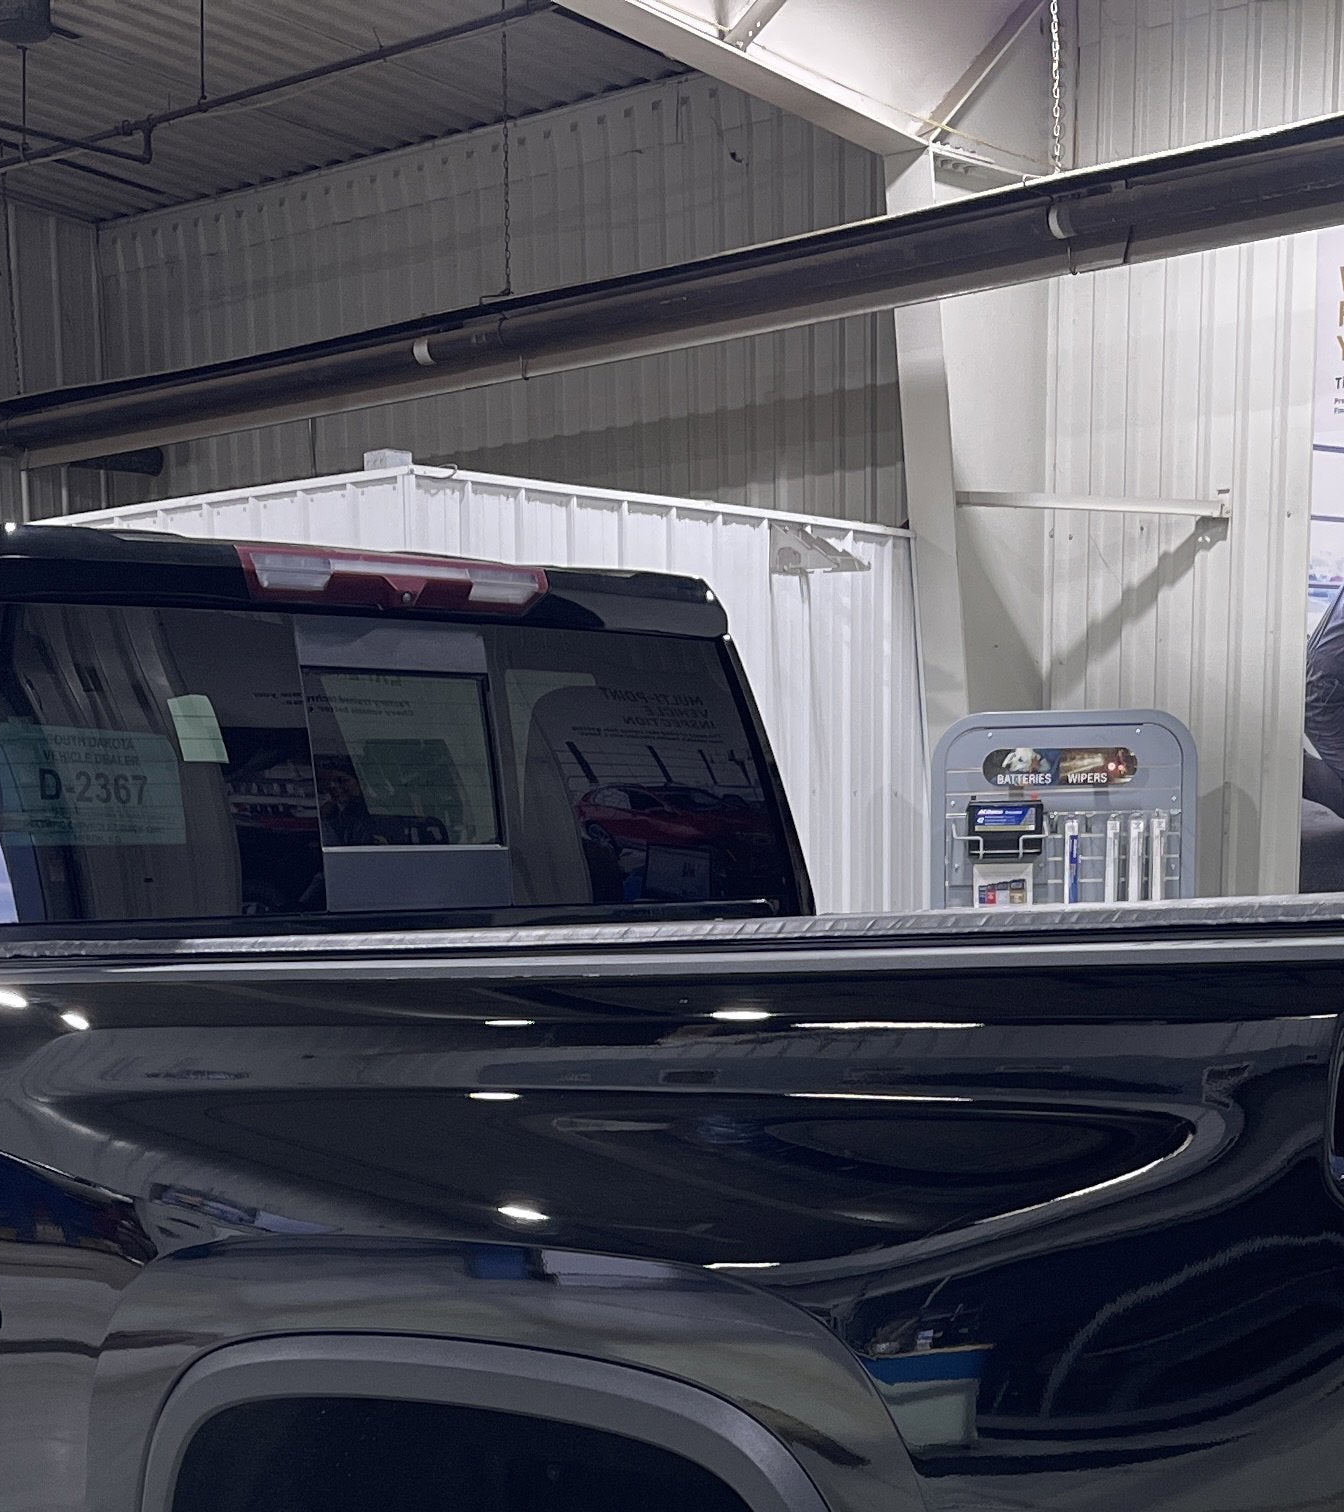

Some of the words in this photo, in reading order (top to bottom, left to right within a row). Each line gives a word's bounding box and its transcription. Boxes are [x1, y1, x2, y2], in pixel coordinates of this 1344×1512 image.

[42, 748, 92, 761] VEHICLE
[93, 752, 141, 767] DEALER
[38, 766, 148, 806] D-2367
[997, 773, 1052, 785] BATTERIES
[1067, 772, 1108, 784] WIPERS
